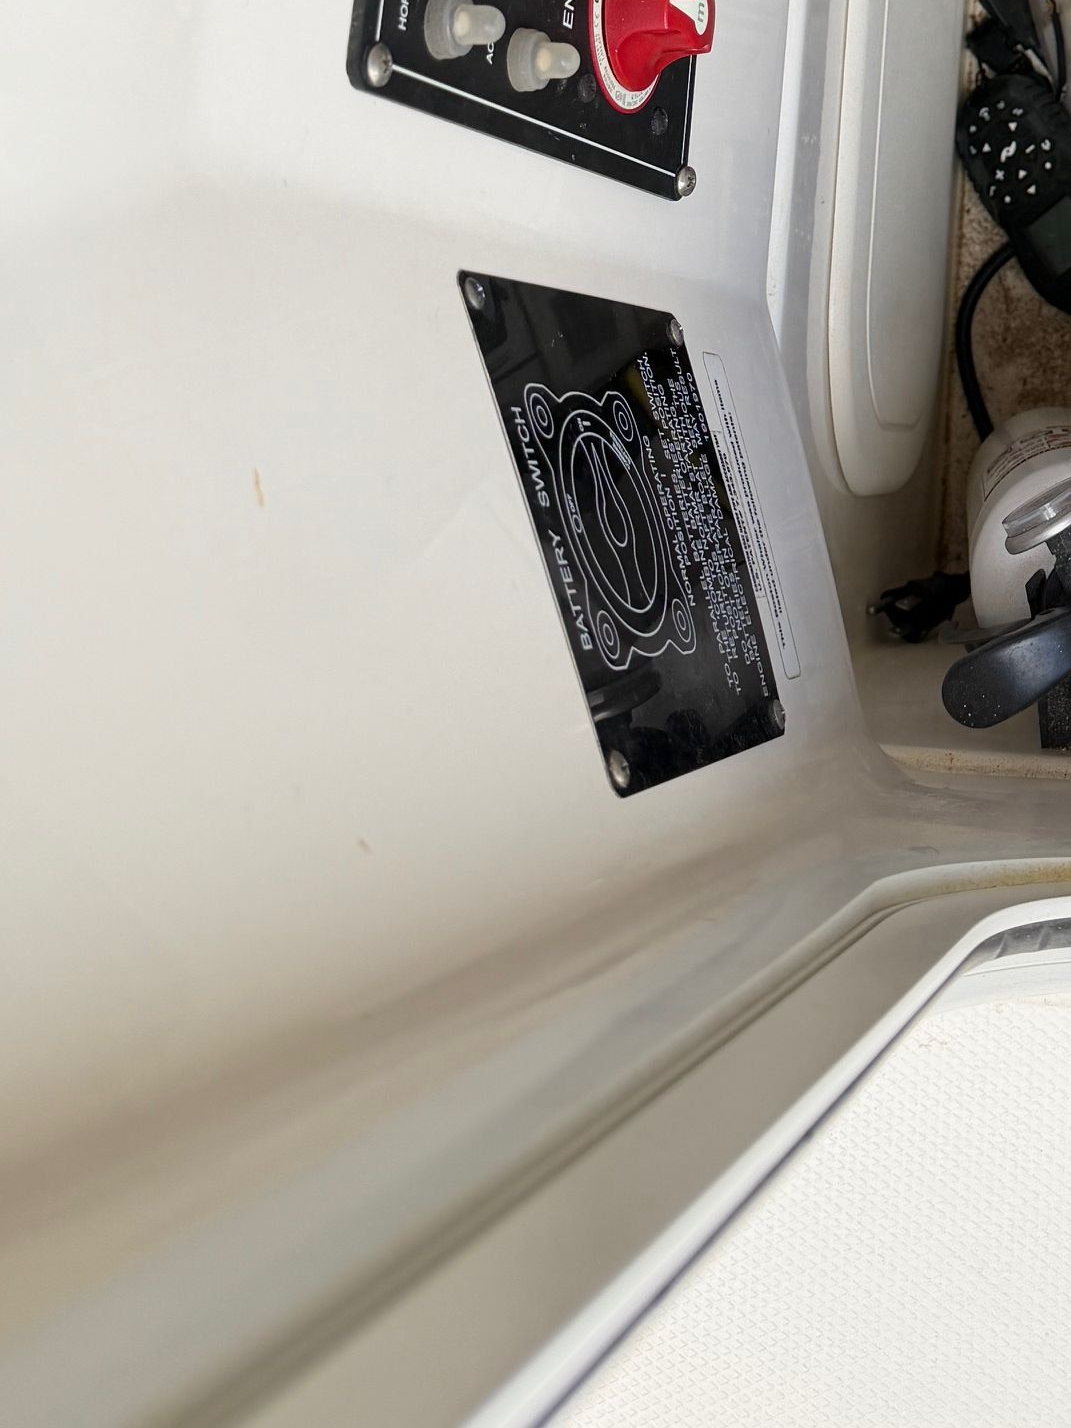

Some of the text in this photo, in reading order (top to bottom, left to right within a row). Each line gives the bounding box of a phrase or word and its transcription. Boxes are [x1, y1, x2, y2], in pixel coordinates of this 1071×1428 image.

[637, 359, 659, 420] SWITCH
[674, 381, 697, 448] SERIOUS
[657, 428, 671, 459] SET
[689, 413, 702, 444] MAY
[700, 454, 723, 519] DAMAGE
[730, 441, 748, 497] produced
[510, 407, 593, 652] BATTERY SWITCH
[642, 435, 695, 605] NORMAL OPERATING
[657, 384, 737, 658] RETURN TO NORMAL OPERATING
[664, 487, 690, 565] POSITION
[667, 378, 750, 664] DO NOT OPERATE BOAT WITH THE
[694, 491, 713, 542] AFTER
[711, 551, 738, 638] POSITIONS
[723, 528, 751, 624] ELECTRICAL
[699, 571, 725, 653] PARALLEL
[728, 572, 754, 660] BATTERIES
[720, 630, 732, 662] THE
[724, 662, 733, 687] TO
[748, 634, 768, 696] ENGINE
[732, 671, 741, 694] TO
